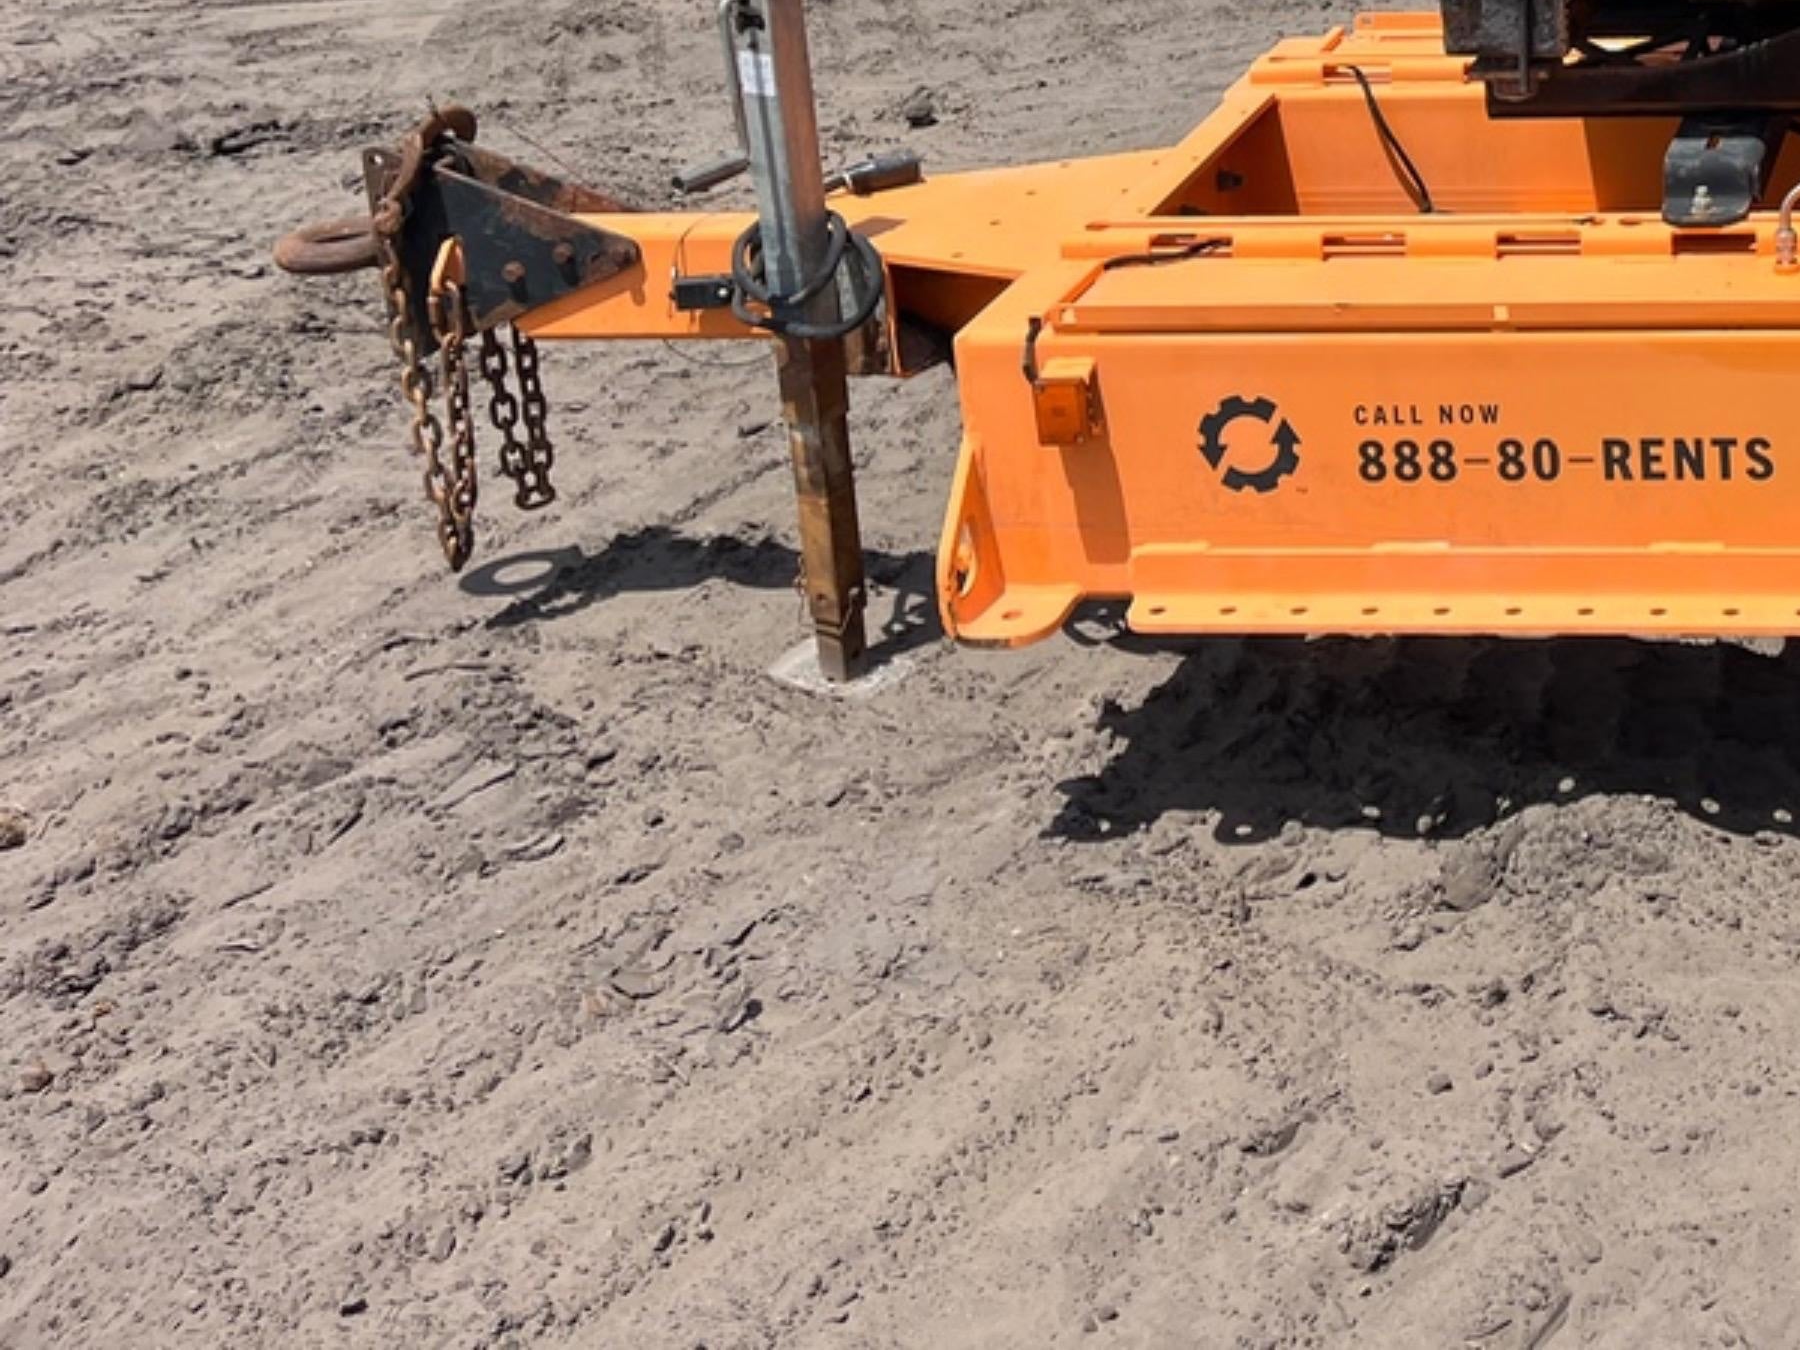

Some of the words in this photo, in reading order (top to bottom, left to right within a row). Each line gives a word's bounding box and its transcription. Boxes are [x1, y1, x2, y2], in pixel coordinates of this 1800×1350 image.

[1353, 404, 1423, 425] CALL
[1438, 404, 1500, 425] NOW
[1357, 437, 1775, 481] 888-80-RENTS
